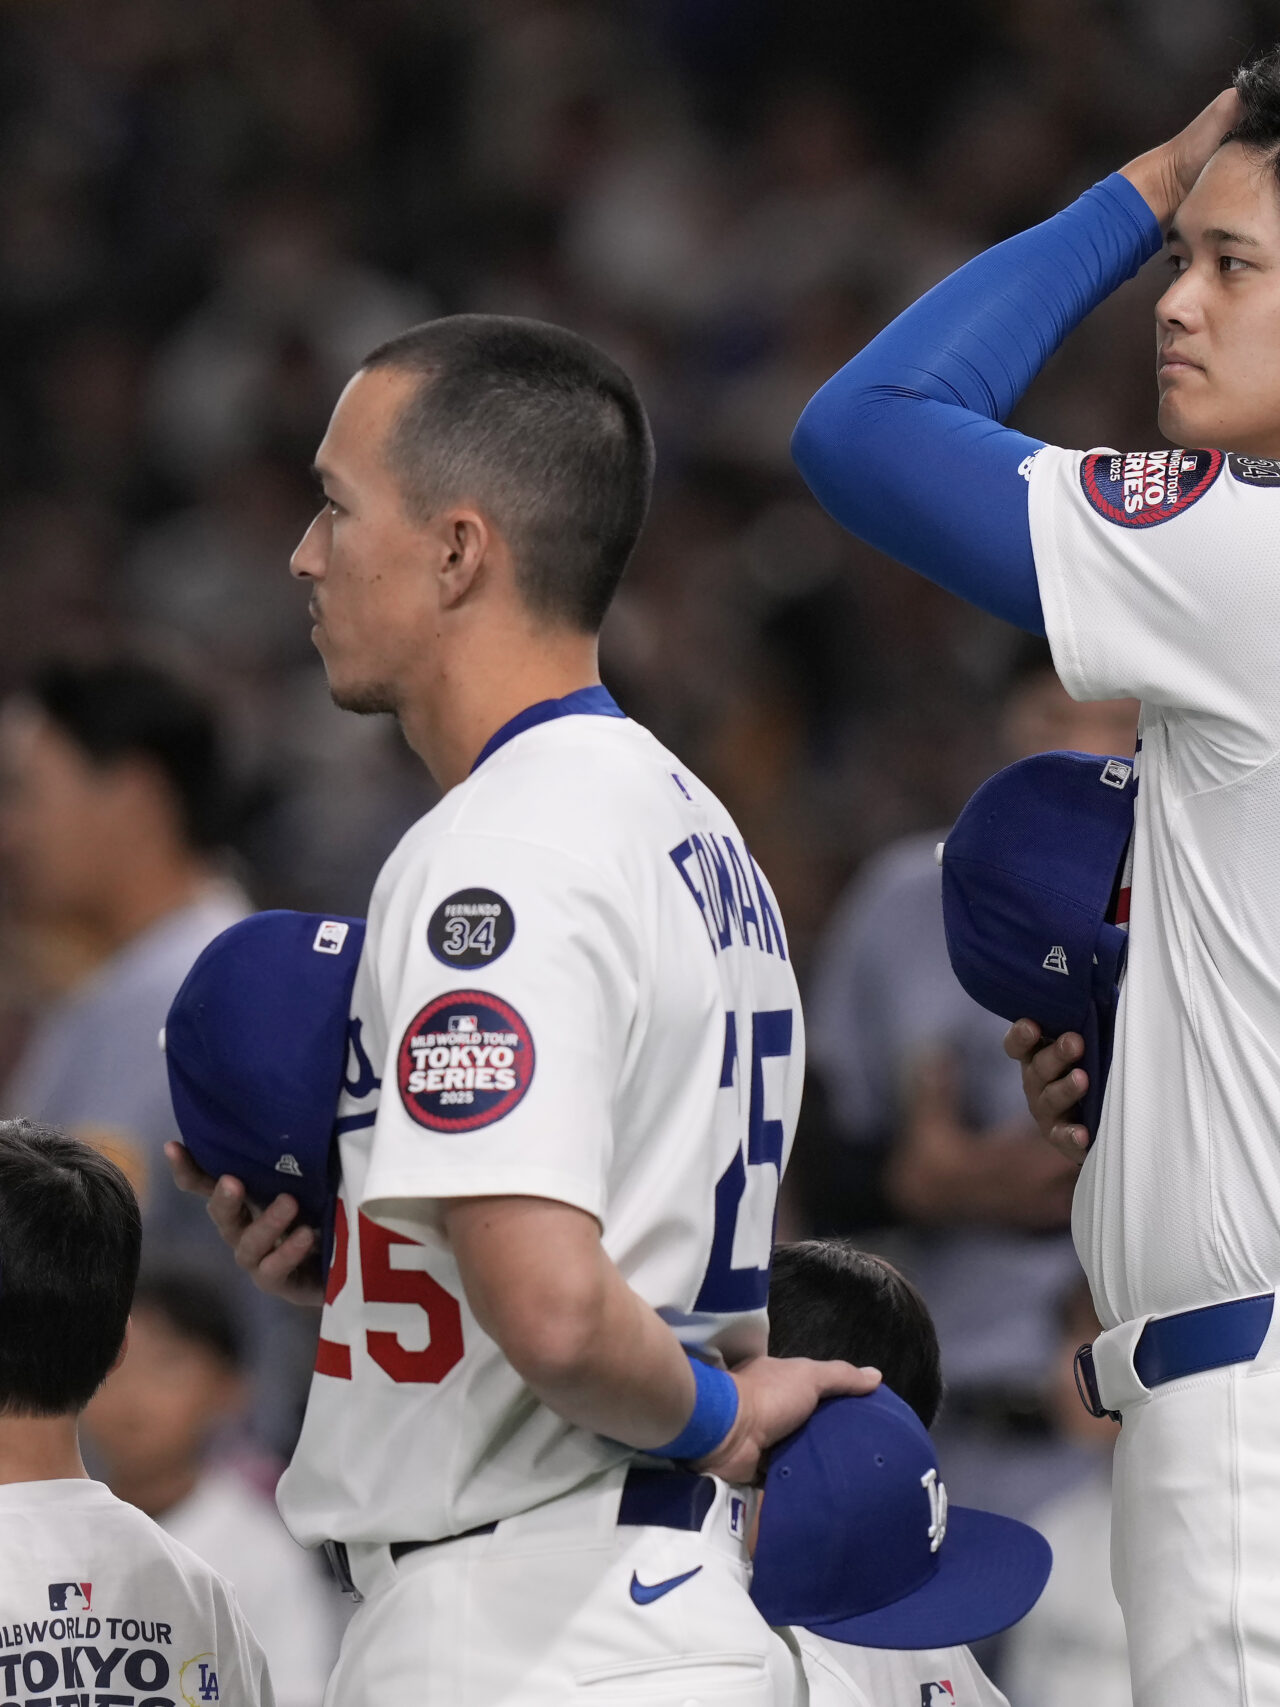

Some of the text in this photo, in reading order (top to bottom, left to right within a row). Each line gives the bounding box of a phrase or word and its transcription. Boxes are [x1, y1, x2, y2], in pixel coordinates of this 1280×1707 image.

[1110, 458, 1121, 481] 2025
[1124, 452, 1148, 513] ERIES
[1145, 450, 1170, 505] OKYO
[1167, 477, 1178, 504] TOUR
[443, 917, 496, 955] 34
[411, 1031, 519, 1048] MLB WORLD TOUR
[411, 1045, 515, 1070] TOKYO
[407, 1067, 517, 1093] SERIES
[438, 1090, 475, 1105] 2025
[24, 1617, 101, 1643] WORLD
[106, 1618, 172, 1644] TOUR
[0, 1646, 170, 1696] TOKYO
